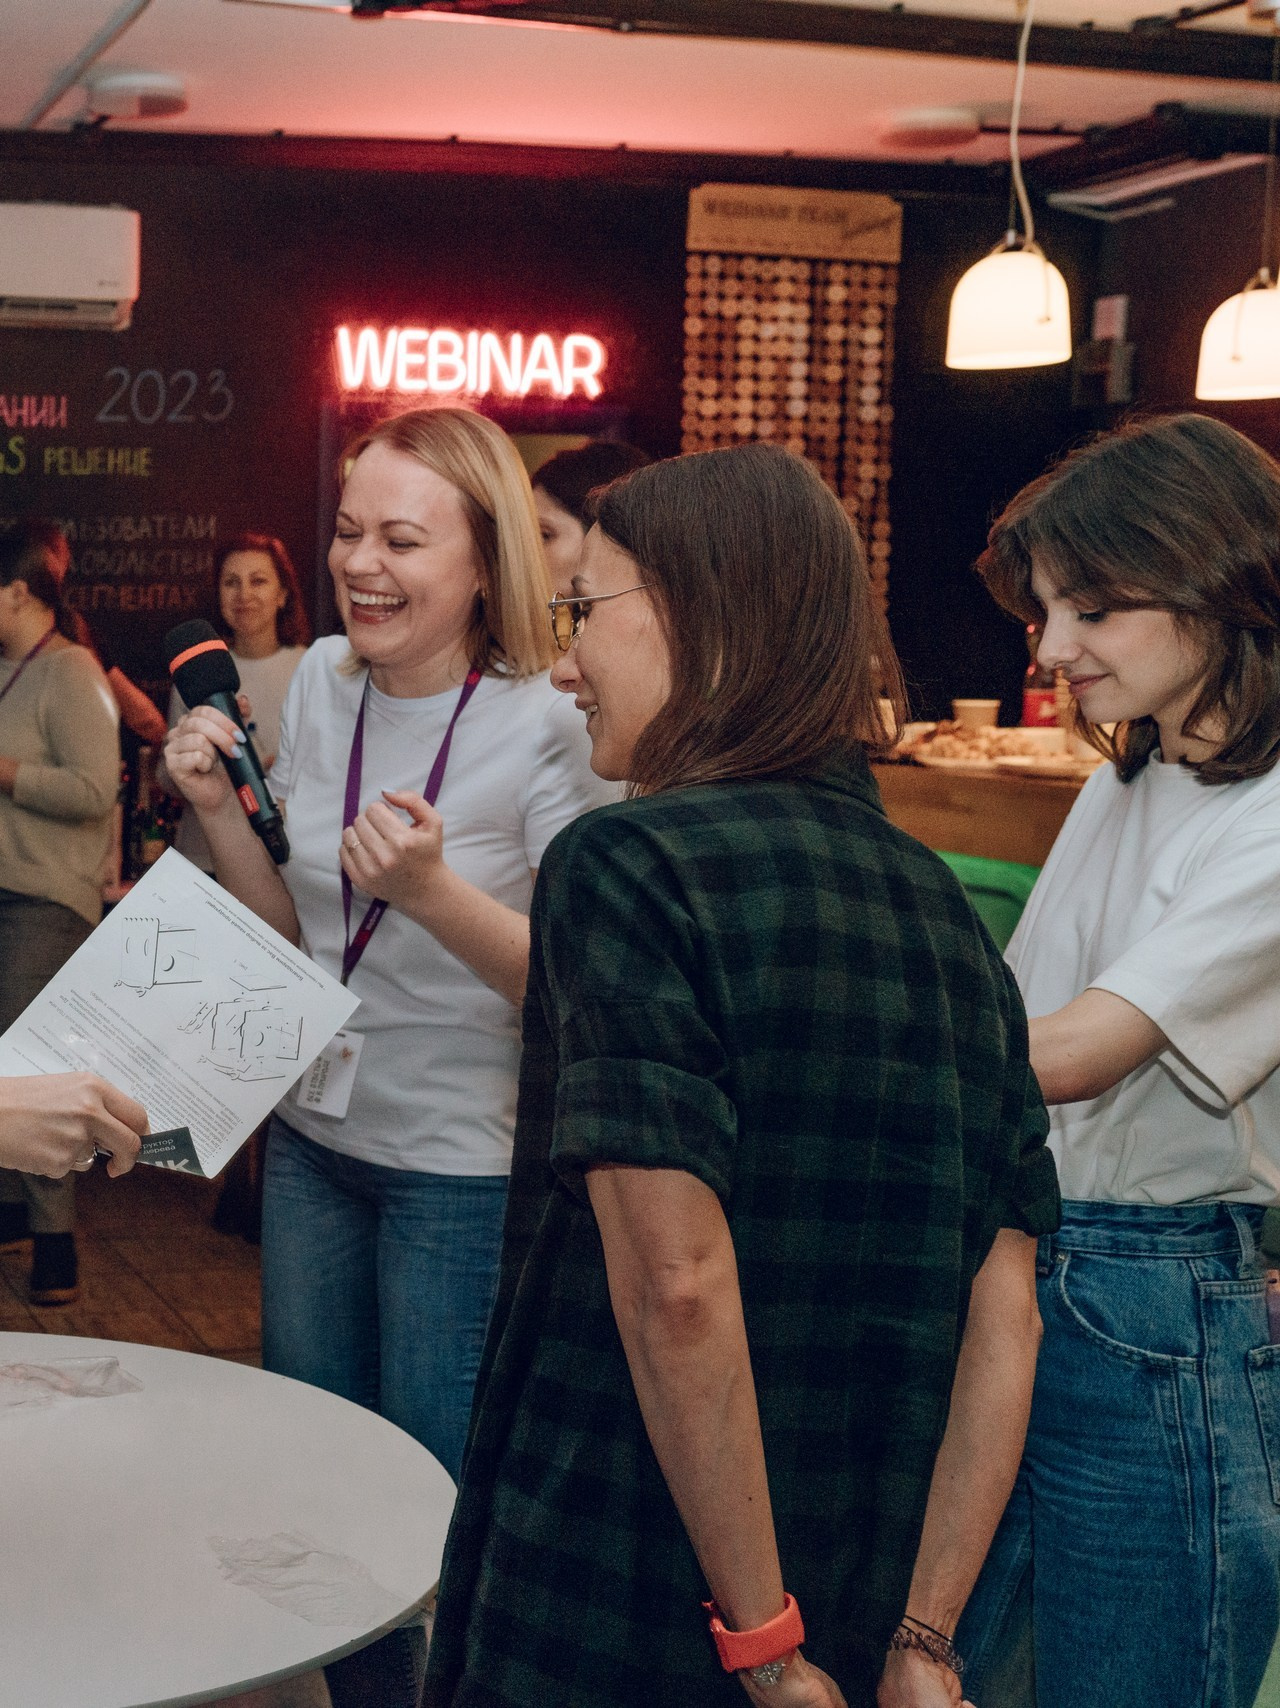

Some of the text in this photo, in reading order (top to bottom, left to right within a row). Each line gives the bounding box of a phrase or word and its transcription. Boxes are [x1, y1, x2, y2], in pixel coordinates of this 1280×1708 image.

[335, 325, 605, 400] WEBINAR
[97, 367, 234, 424] 2023
[44, 447, 151, 476] РЕШЕНИЕ
[265, 949, 276, 959] Вас
[274, 956, 304, 981] Благодарим
